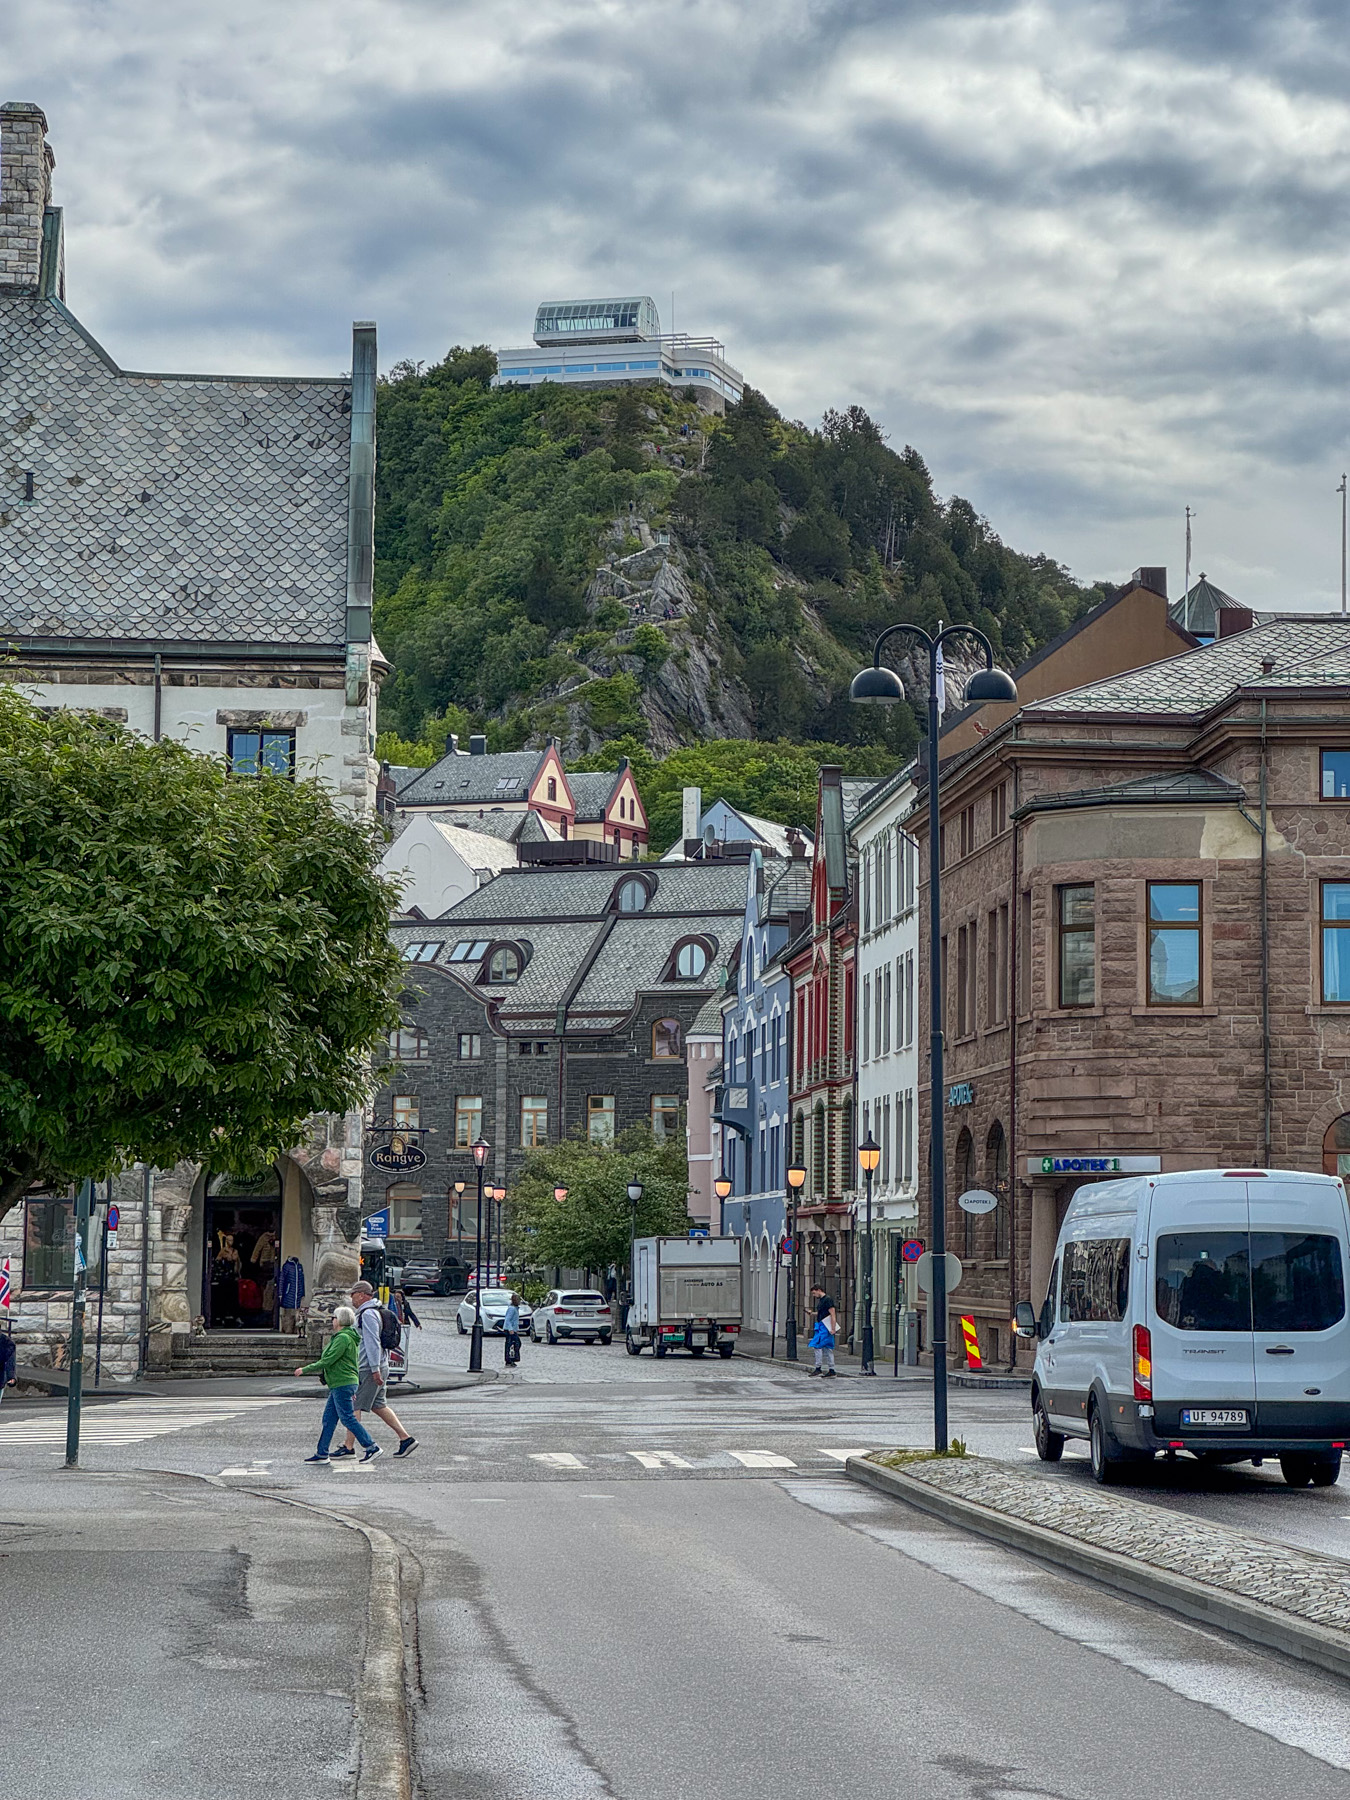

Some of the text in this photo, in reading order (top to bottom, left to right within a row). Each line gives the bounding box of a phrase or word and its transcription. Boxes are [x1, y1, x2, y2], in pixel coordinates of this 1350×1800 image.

[376, 1153, 421, 1165] Rongve
[1053, 1158, 1120, 1171] APOTEK 1
[1192, 1411, 1244, 1422] UF 94789
